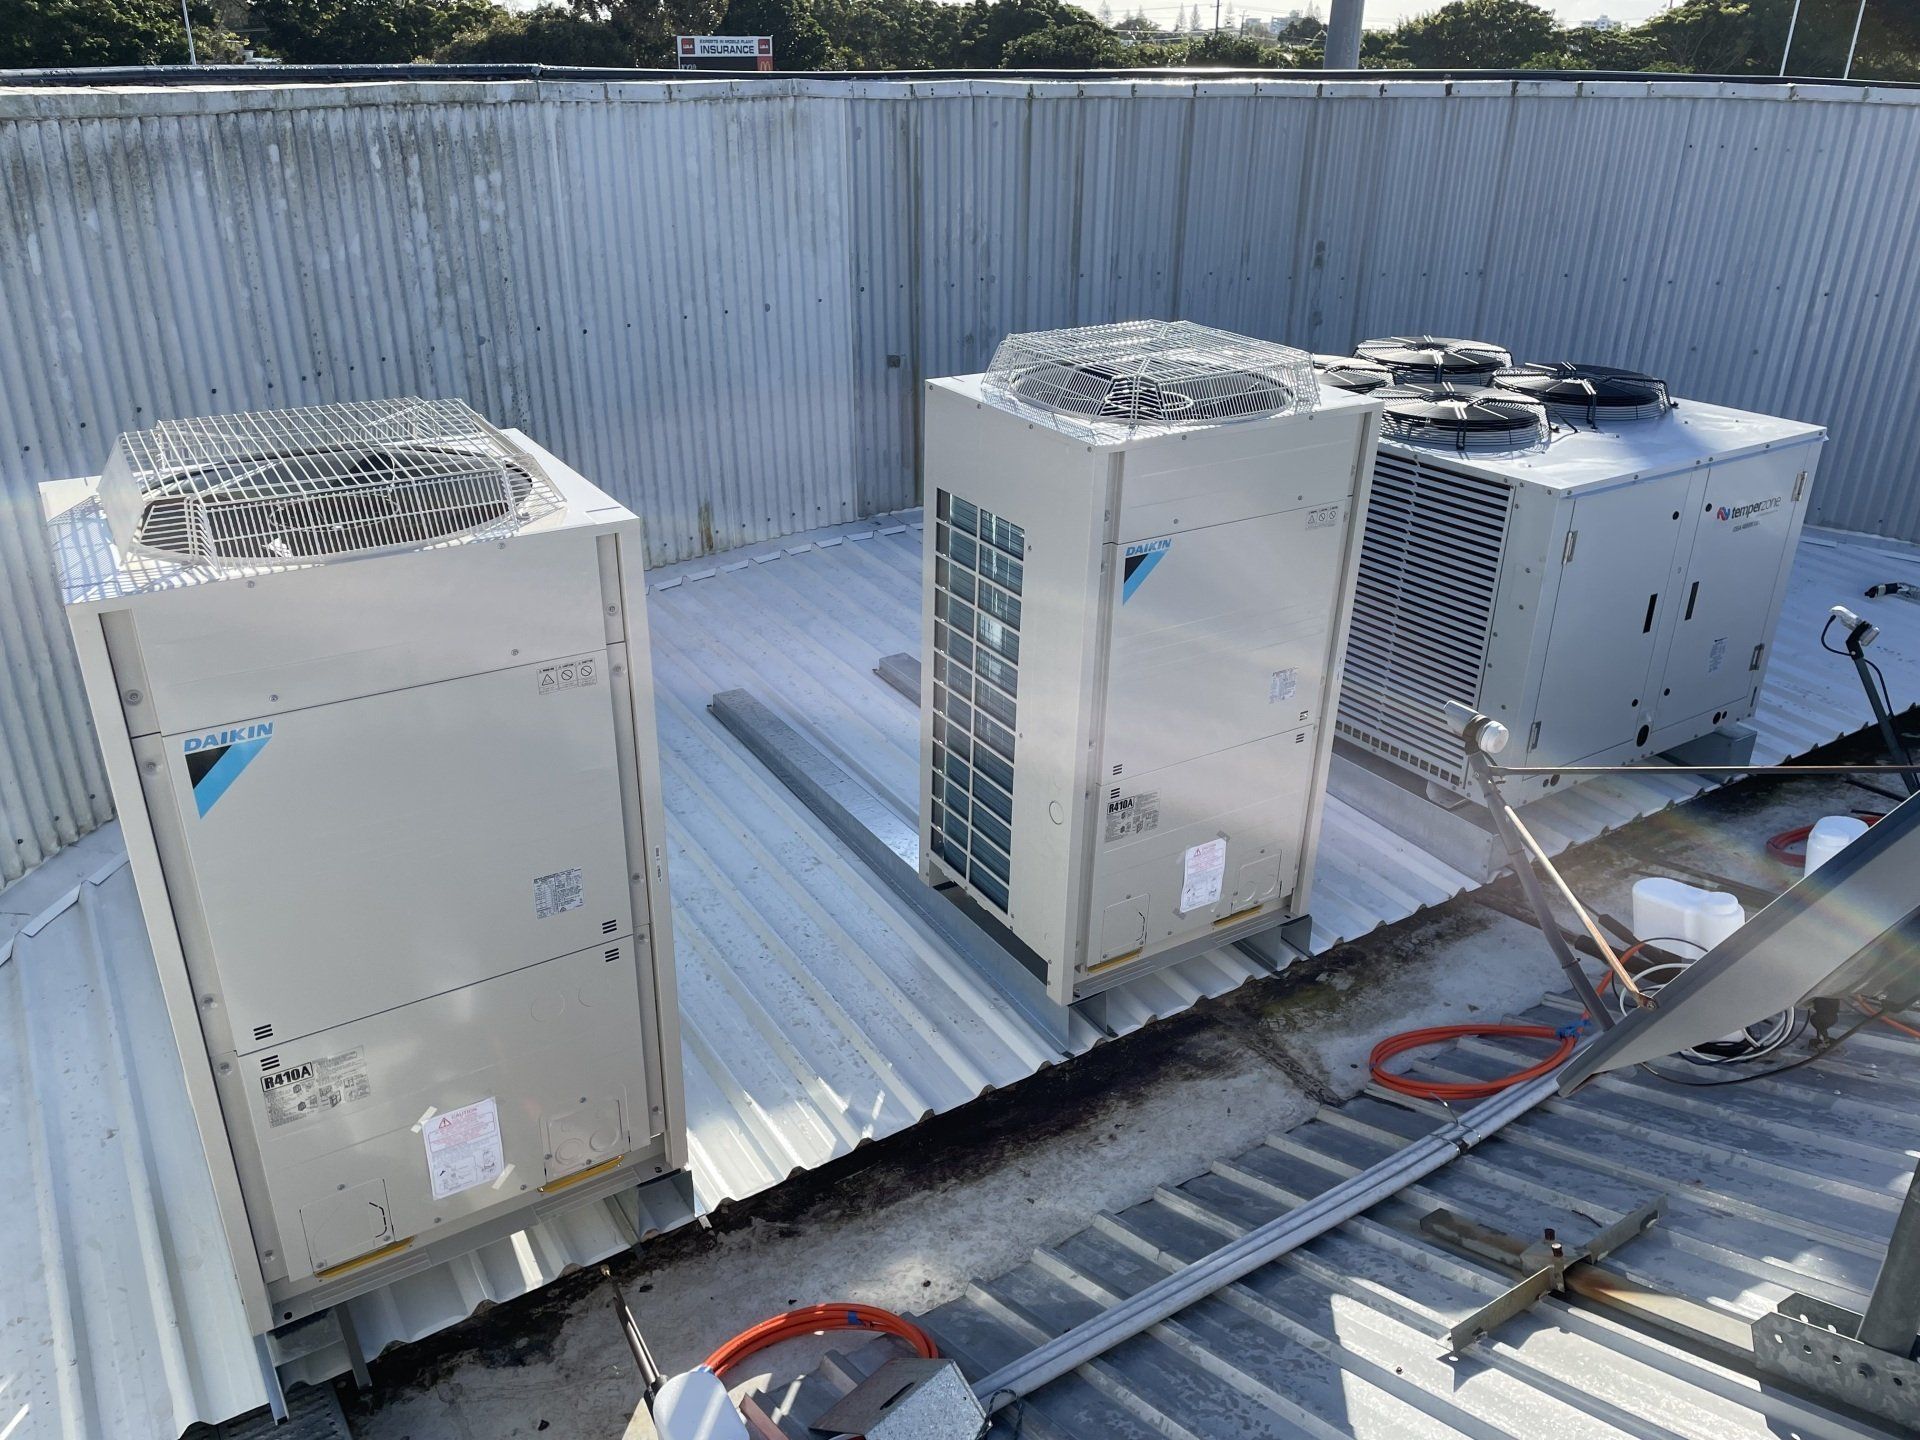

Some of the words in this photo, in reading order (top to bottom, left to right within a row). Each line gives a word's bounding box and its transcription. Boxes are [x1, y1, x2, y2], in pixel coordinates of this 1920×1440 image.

[700, 45, 755, 54] INSURANCE
[1731, 496, 1782, 519] temperzone
[1125, 538, 1172, 556] DAIKIN
[184, 722, 273, 753] DAIKIN
[1108, 798, 1133, 814] R410A
[264, 1065, 312, 1090] R410A
